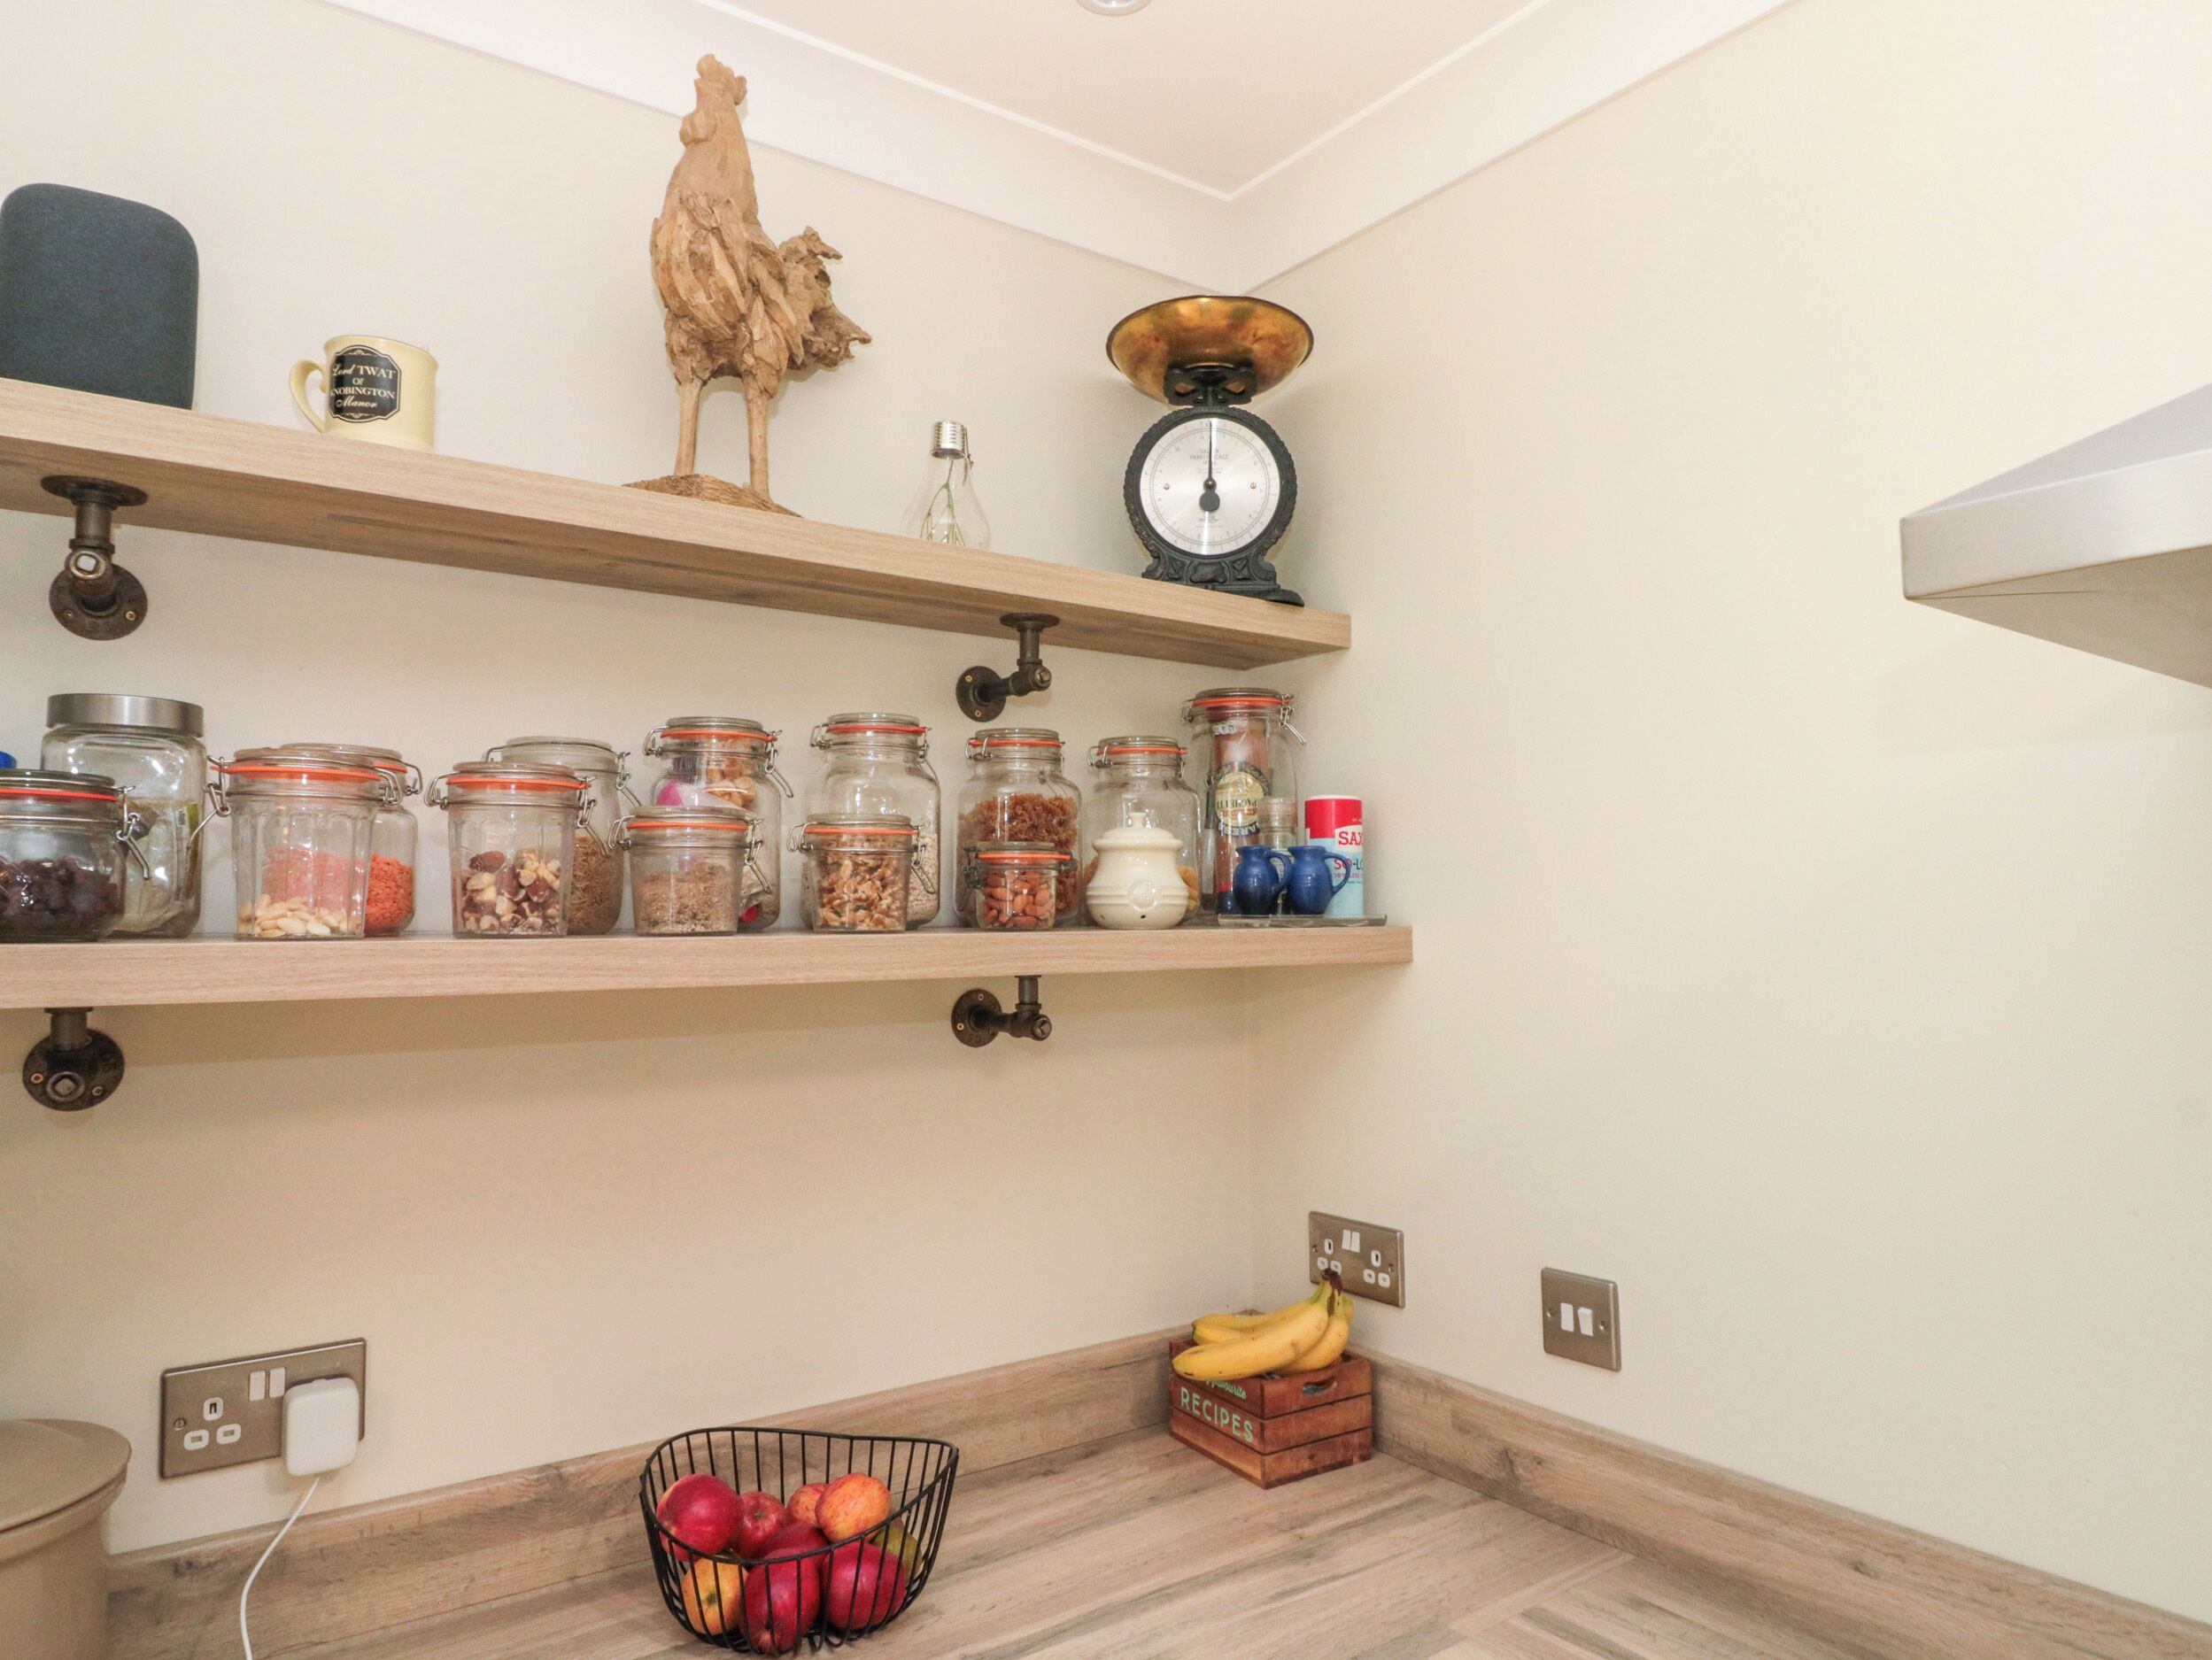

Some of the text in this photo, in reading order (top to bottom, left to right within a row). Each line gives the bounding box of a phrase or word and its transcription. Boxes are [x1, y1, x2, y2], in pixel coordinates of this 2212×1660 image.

[332, 364, 397, 379] Lord TWAT
[336, 395, 378, 408] Manor
[1180, 1386, 1254, 1443] RECIPES
